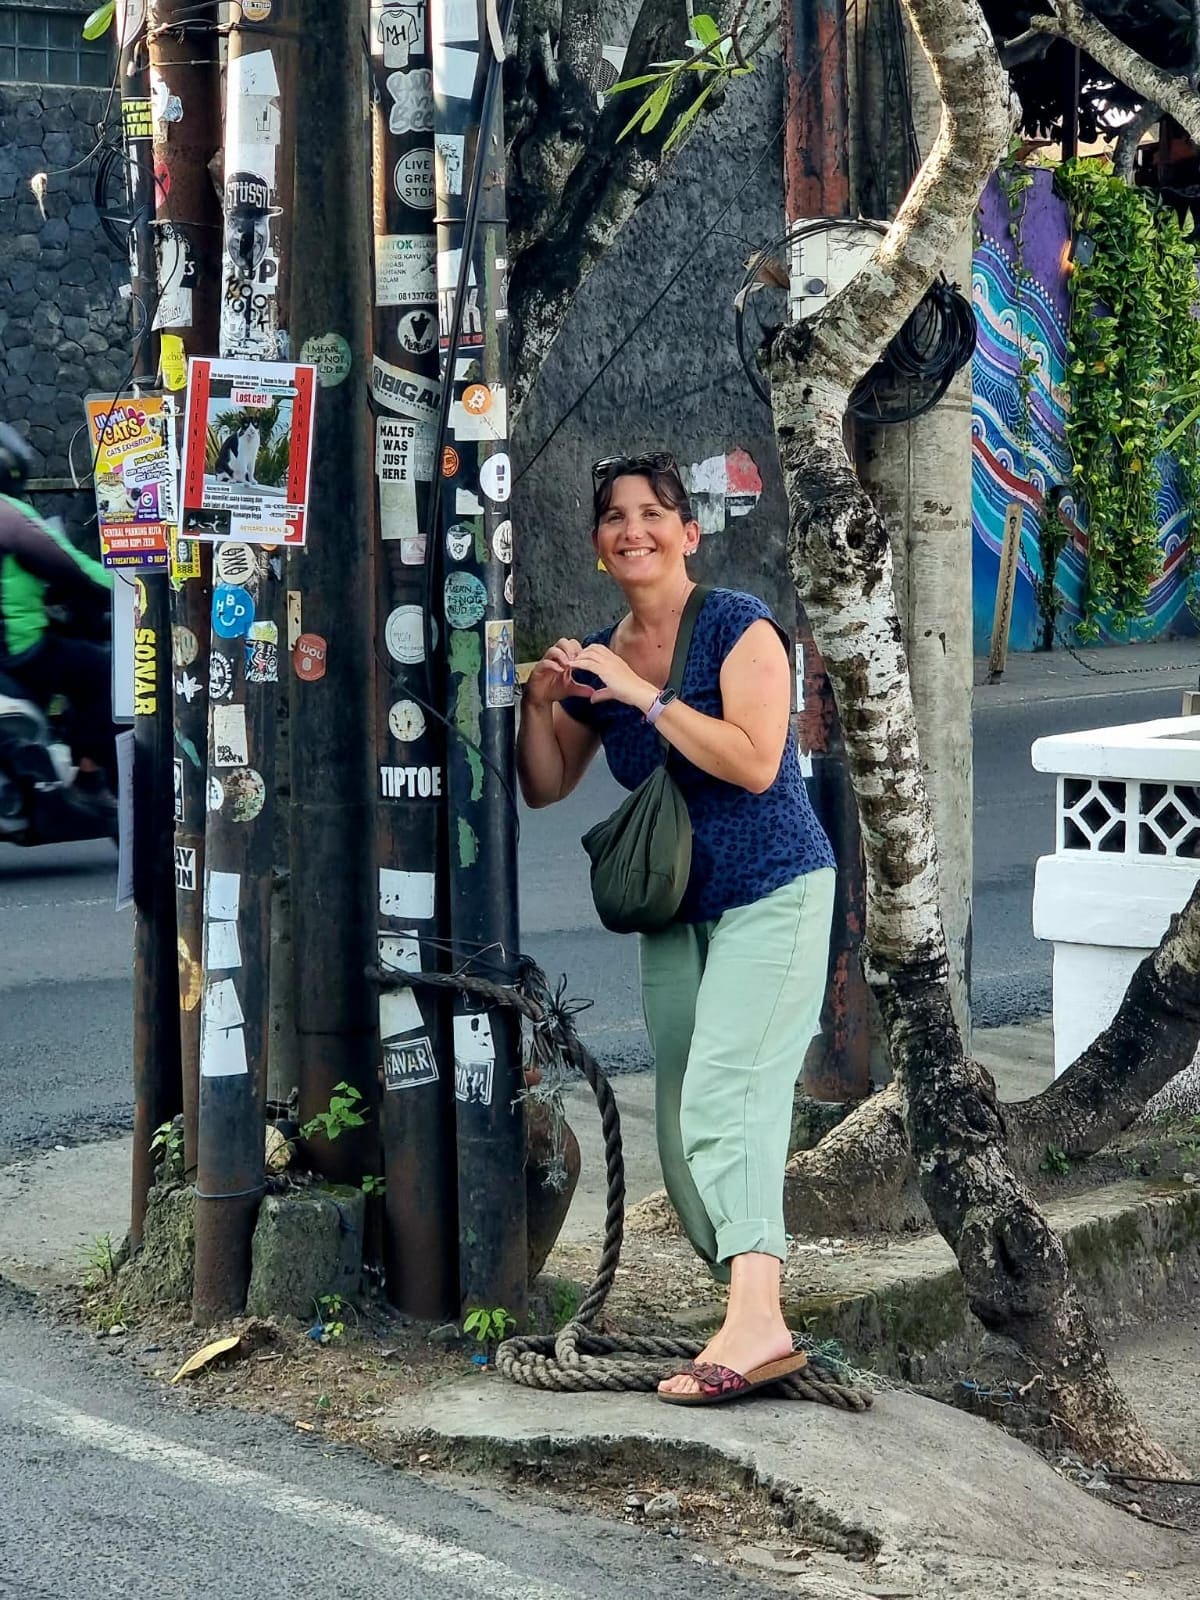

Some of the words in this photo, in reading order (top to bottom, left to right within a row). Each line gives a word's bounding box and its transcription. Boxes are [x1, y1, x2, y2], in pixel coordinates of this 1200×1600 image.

[405, 160, 430, 170] LIVE
[235, 391, 251, 403] Lost
[252, 393, 267, 404] cat!
[102, 417, 141, 446] CATS
[380, 425, 414, 437] MALTS
[106, 447, 121, 457] CATS
[122, 435, 154, 451] EXHIBITION
[383, 439, 408, 451] WAS
[382, 454, 407, 465] JUST
[382, 468, 406, 480] HERE
[134, 628, 157, 715] SONAR
[380, 766, 441, 797] TIPTOE
